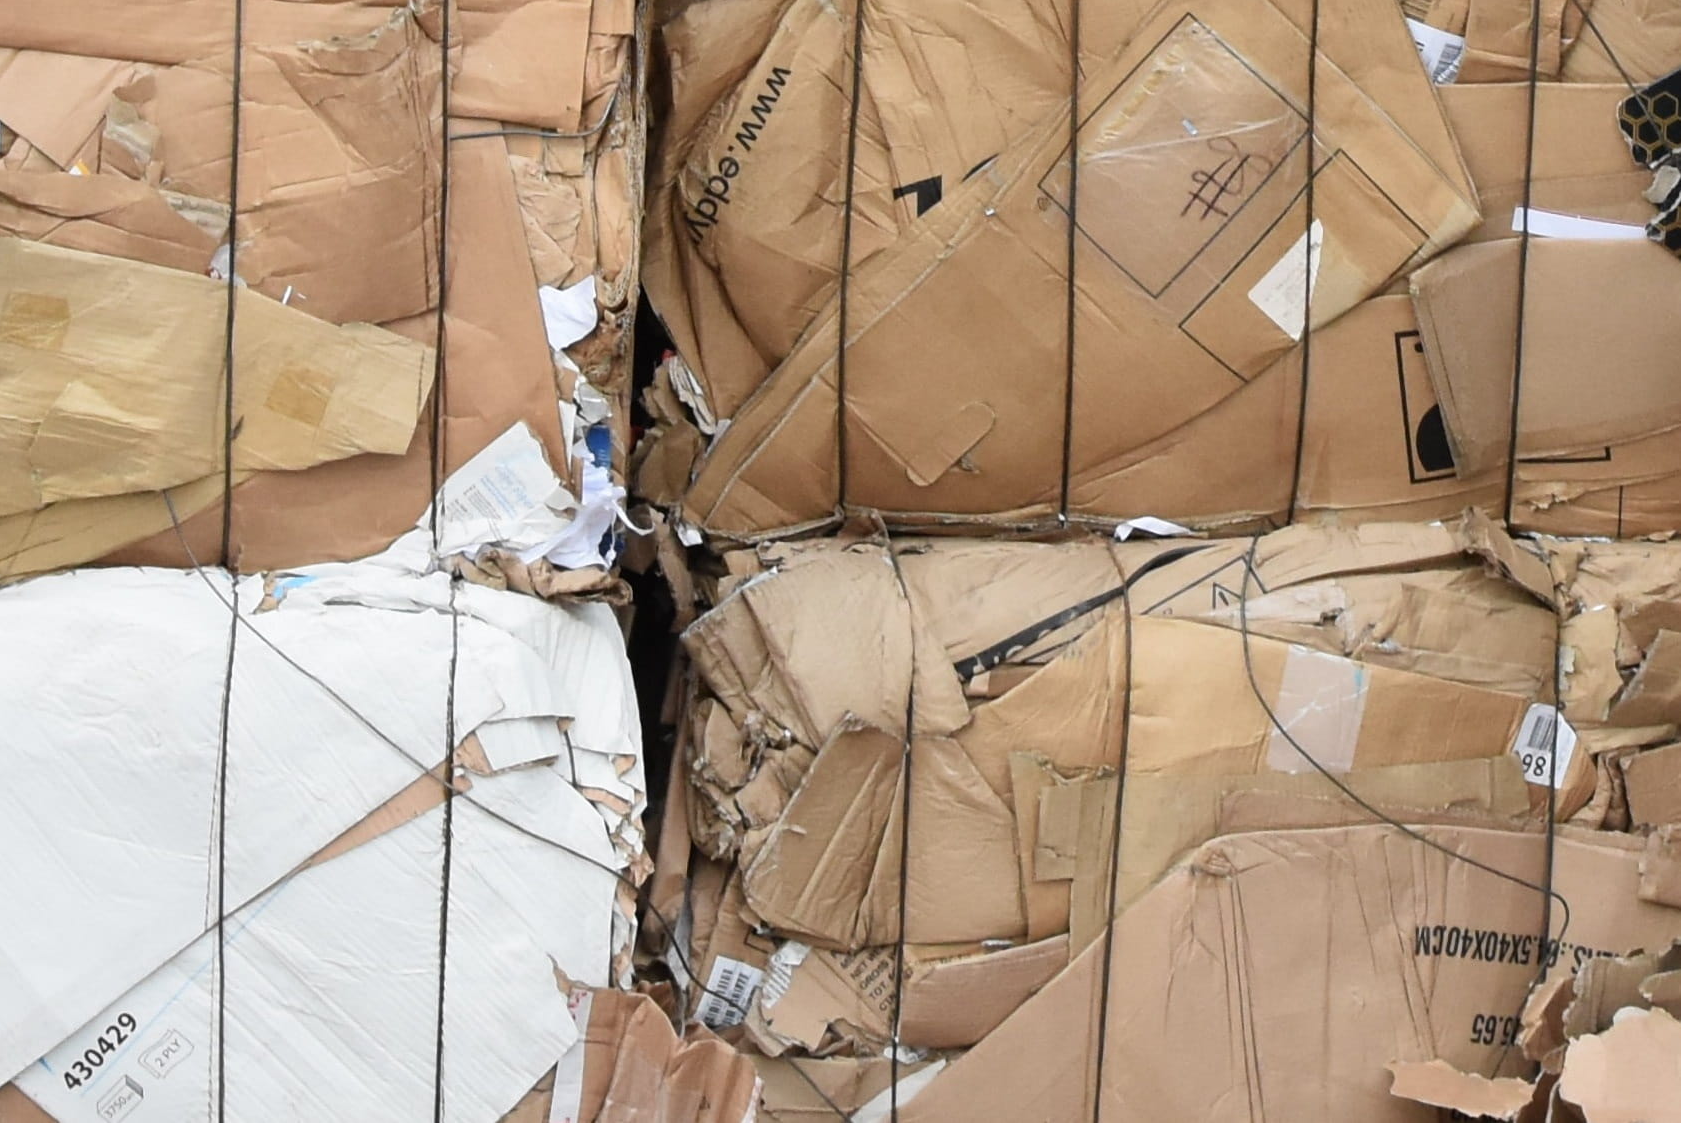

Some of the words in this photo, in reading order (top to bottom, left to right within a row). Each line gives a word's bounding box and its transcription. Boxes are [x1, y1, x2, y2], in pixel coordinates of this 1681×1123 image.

[63, 1012, 137, 1090] 430429
[155, 1057, 165, 1068] 2
[162, 1038, 182, 1060] PLY
